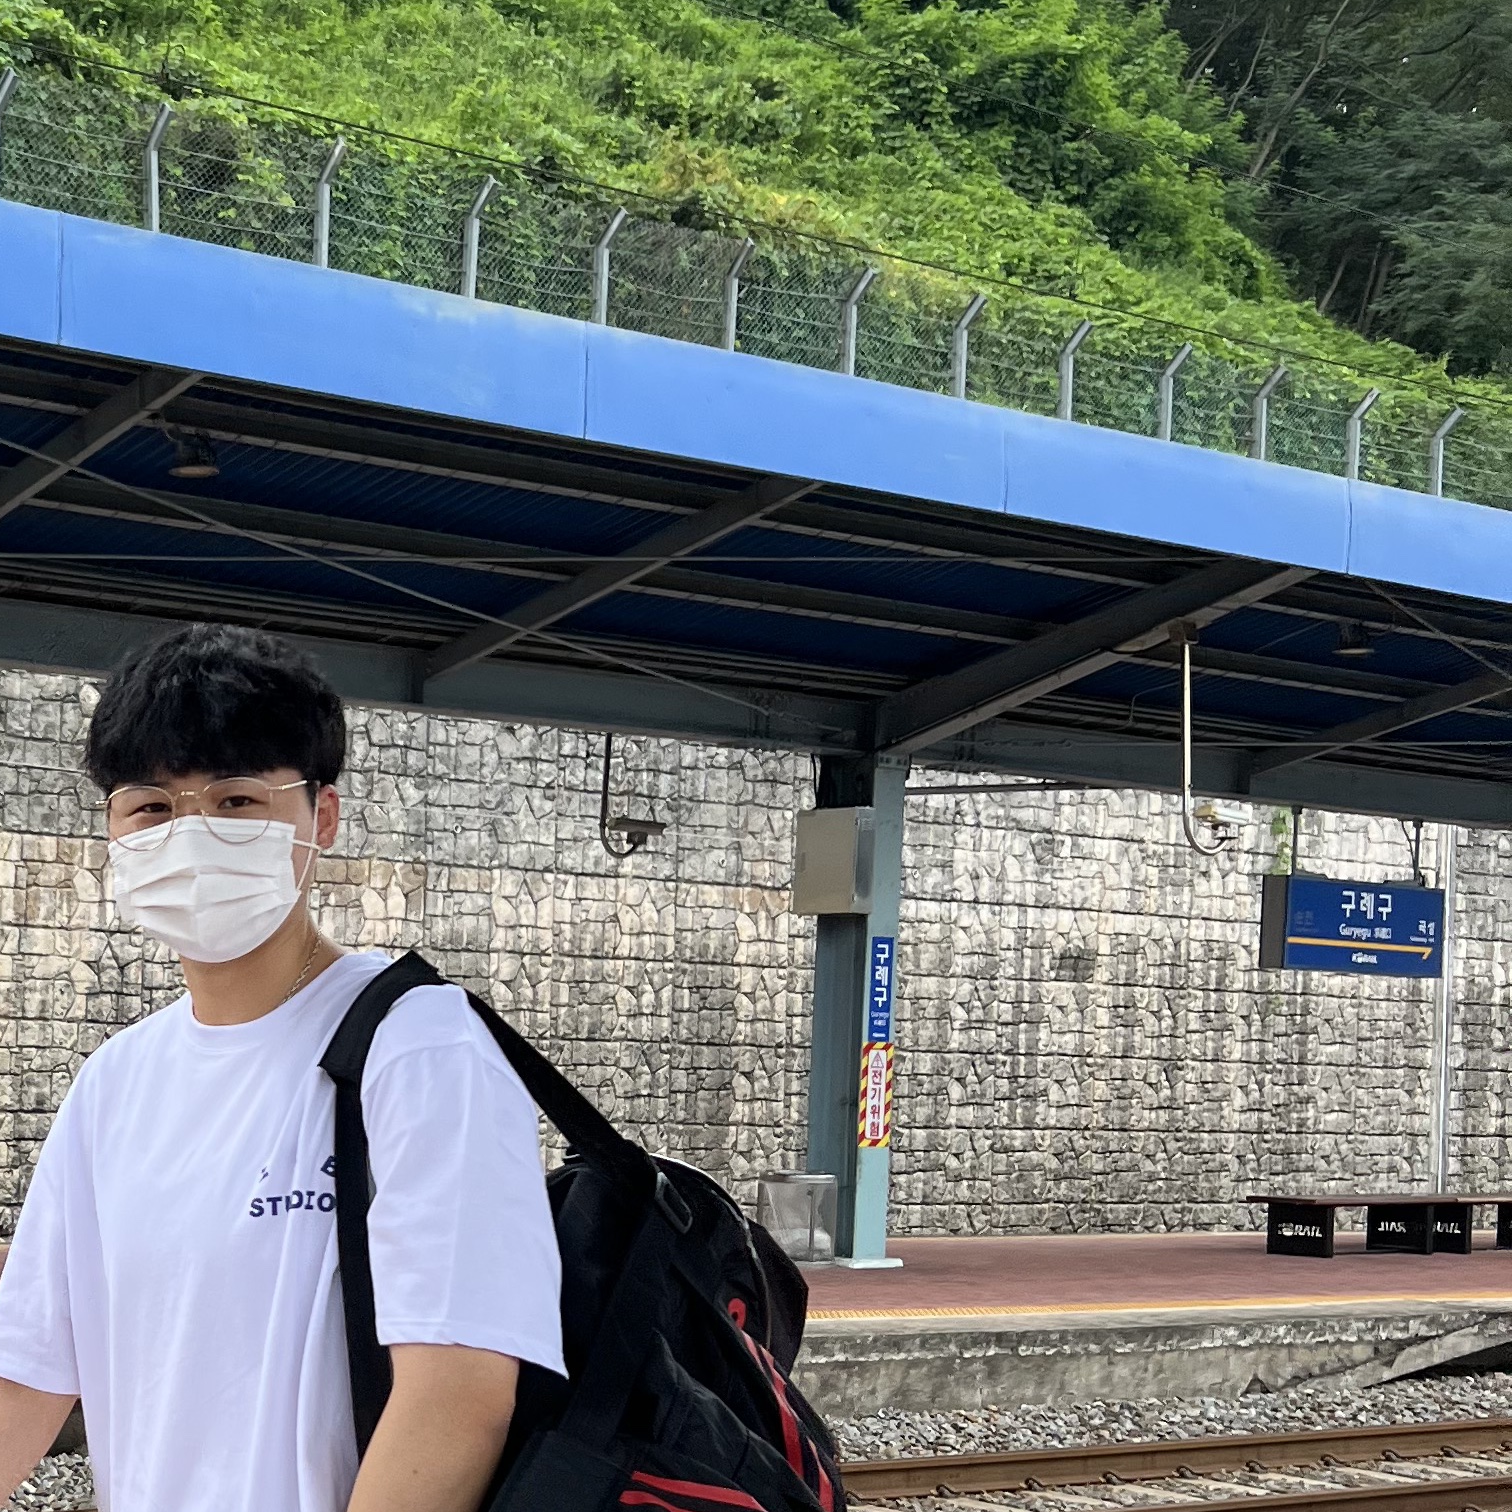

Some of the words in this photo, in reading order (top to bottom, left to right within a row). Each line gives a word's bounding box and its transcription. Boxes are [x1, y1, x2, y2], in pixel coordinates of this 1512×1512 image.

[1341, 890, 1393, 921] 구례구
[874, 943, 890, 1008] 구례구
[869, 1069, 883, 1138] 전기위험
